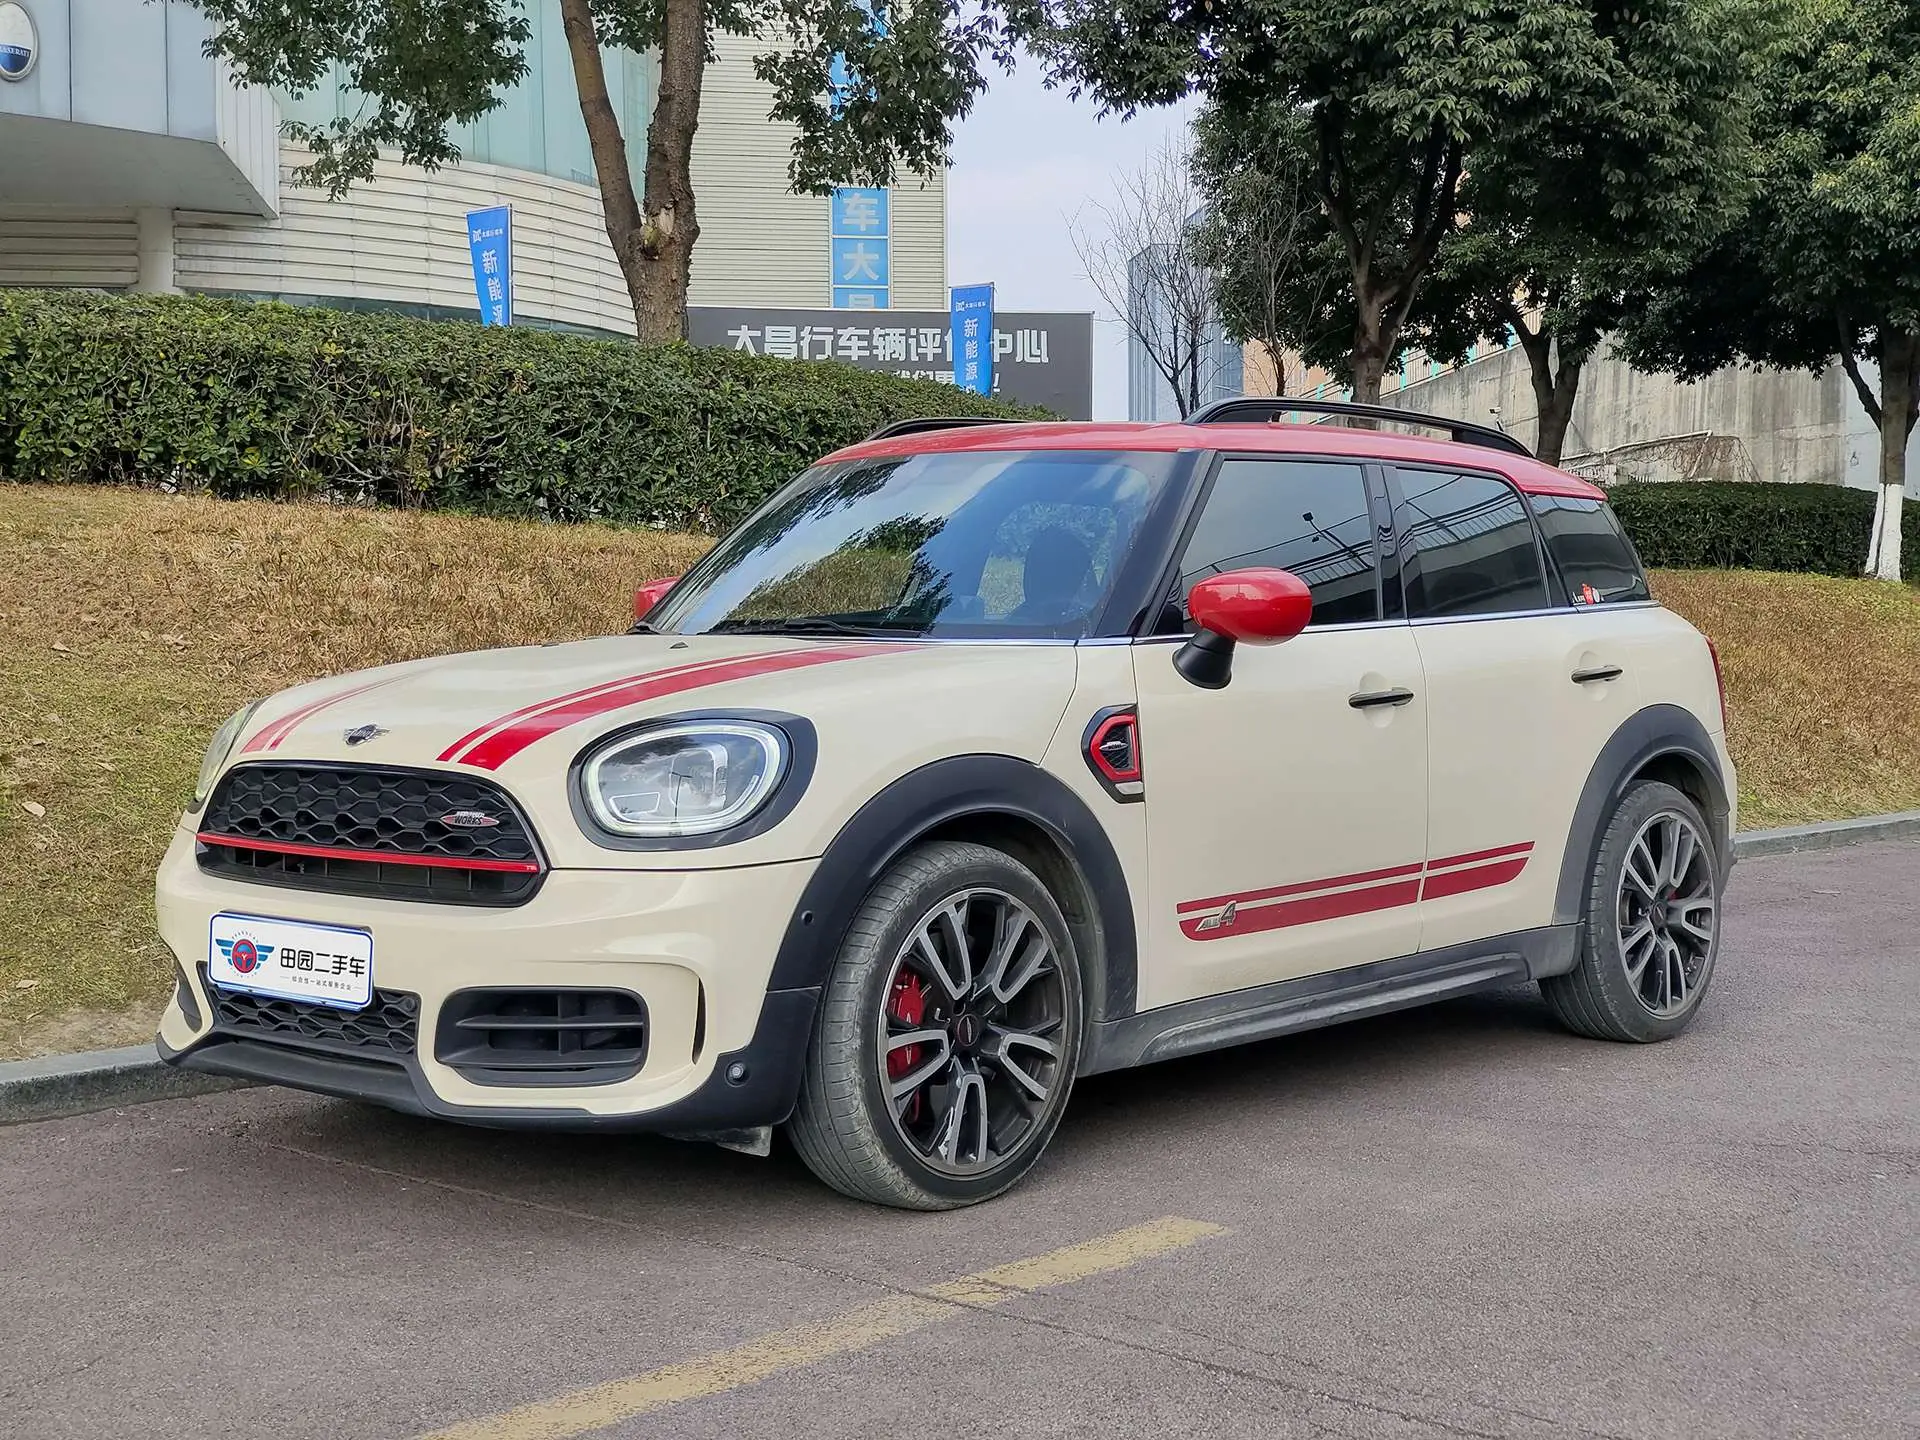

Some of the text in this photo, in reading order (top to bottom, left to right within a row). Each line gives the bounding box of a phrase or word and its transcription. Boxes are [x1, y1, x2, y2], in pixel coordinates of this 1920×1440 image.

[280, 948, 365, 978] 田园二手车
